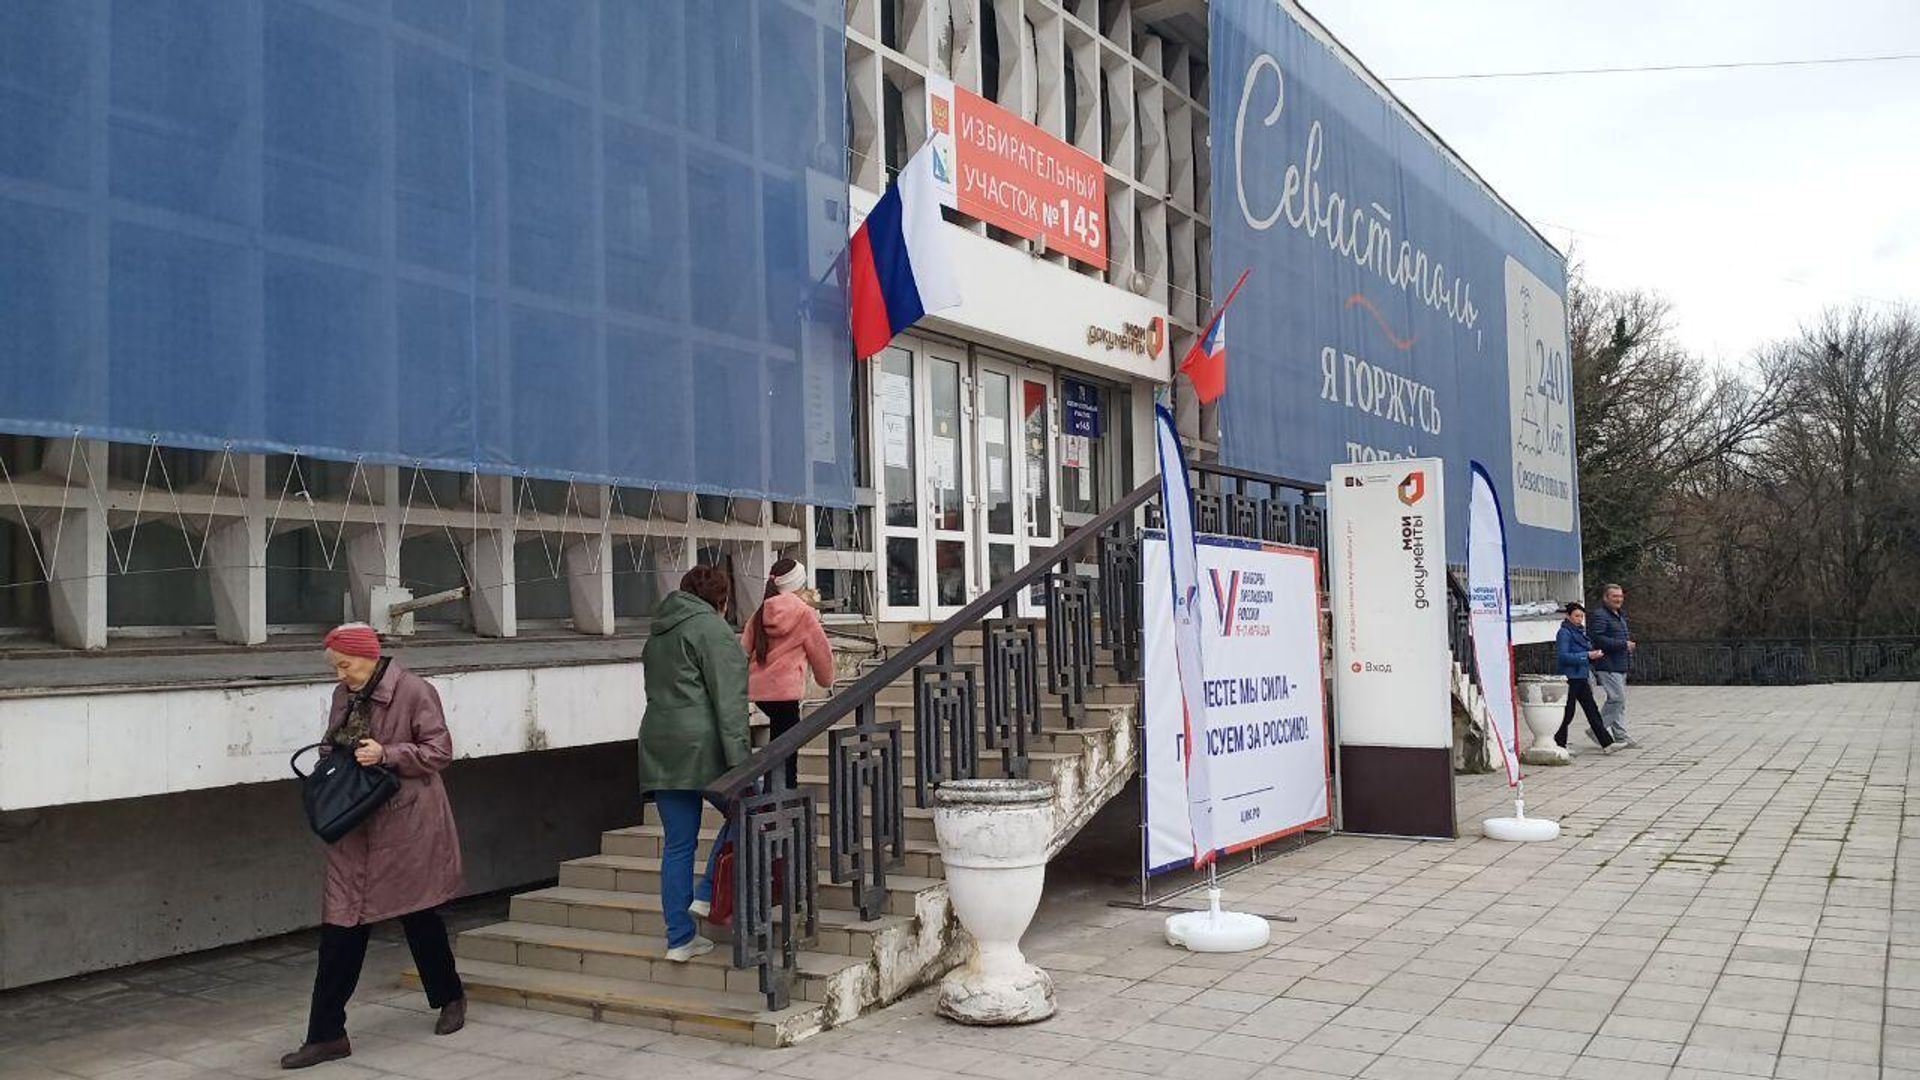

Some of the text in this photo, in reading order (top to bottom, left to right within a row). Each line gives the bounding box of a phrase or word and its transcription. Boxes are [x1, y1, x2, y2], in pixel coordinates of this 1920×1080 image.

[960, 112, 1098, 201] ИЗБИРАТЕЛЬНЫЙ
[963, 163, 1101, 249] УЧАСТОК №145
[1234, 53, 1484, 353] Севастополь,
[1321, 346, 1441, 435] Я ГОРЖУСЬ
[1536, 337, 1566, 406] 240
[1239, 678, 1259, 704] МЫ
[1261, 675, 1289, 702] СИЛА
[1365, 661, 1393, 674] Вход
[1246, 724, 1262, 750] ЗА
[1263, 716, 1309, 747] РОССИЮ!
